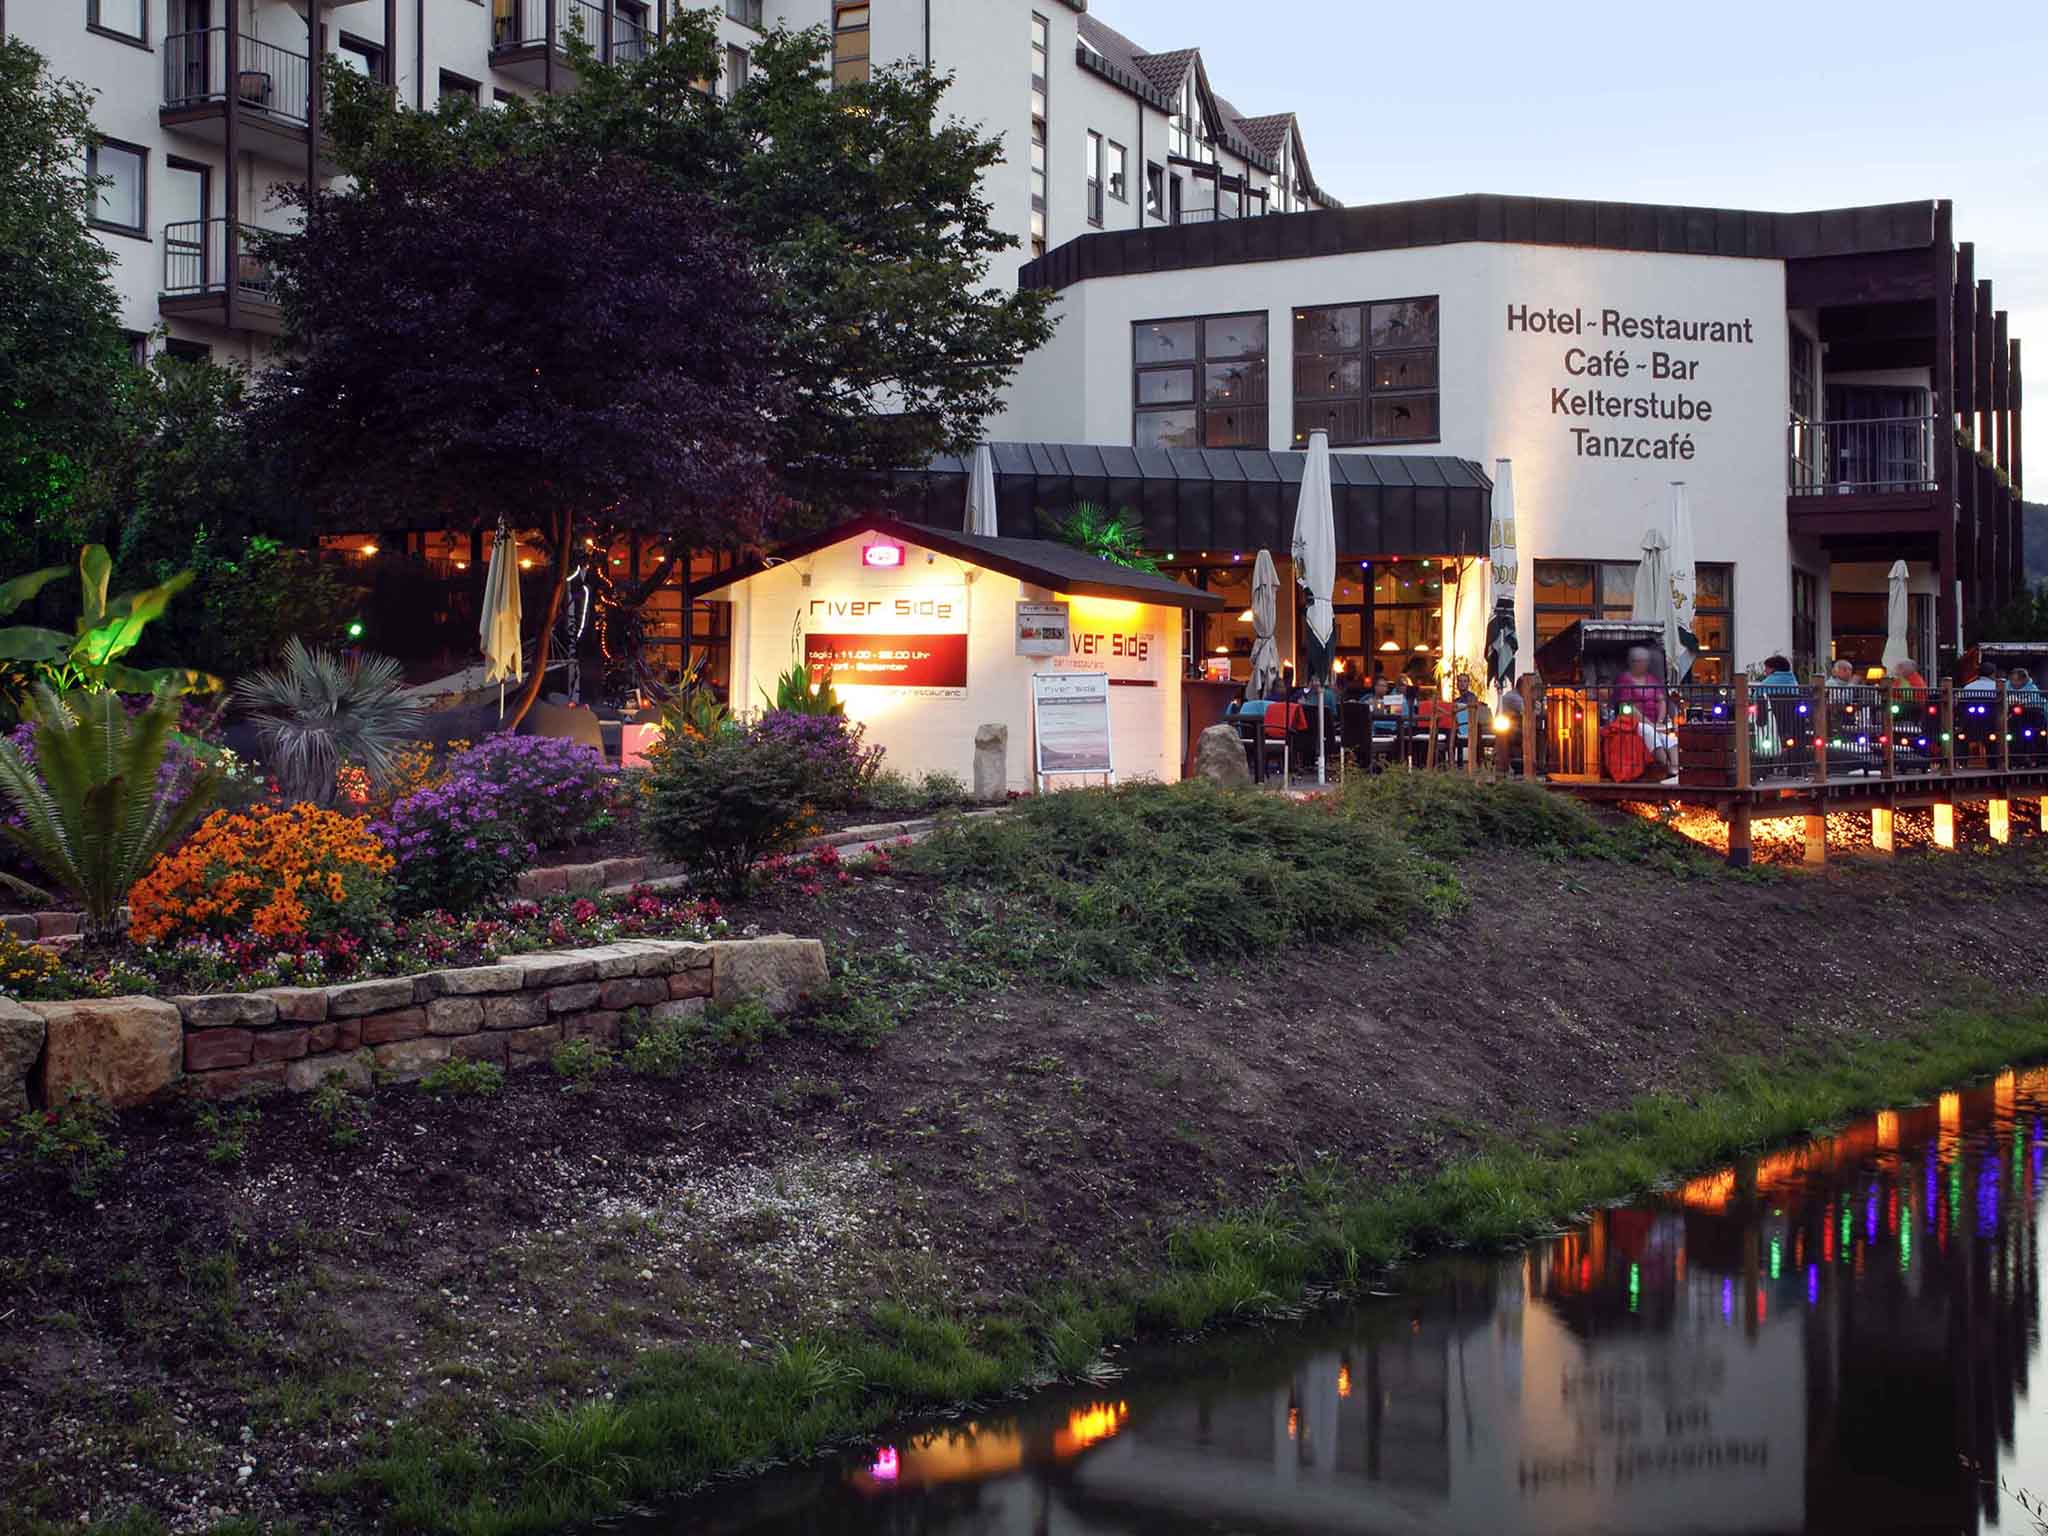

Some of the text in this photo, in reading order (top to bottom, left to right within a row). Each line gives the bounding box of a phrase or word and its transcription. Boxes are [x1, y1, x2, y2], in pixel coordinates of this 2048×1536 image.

[1507, 304, 1582, 335] Hotel
[1602, 309, 1754, 344] Restaurant
[1564, 348, 1629, 377] Café
[1652, 352, 1700, 380] Bar
[1551, 387, 1713, 422] Kelterstube
[1569, 427, 1696, 461] Tanzcafé
[1072, 632, 1104, 654] ver
